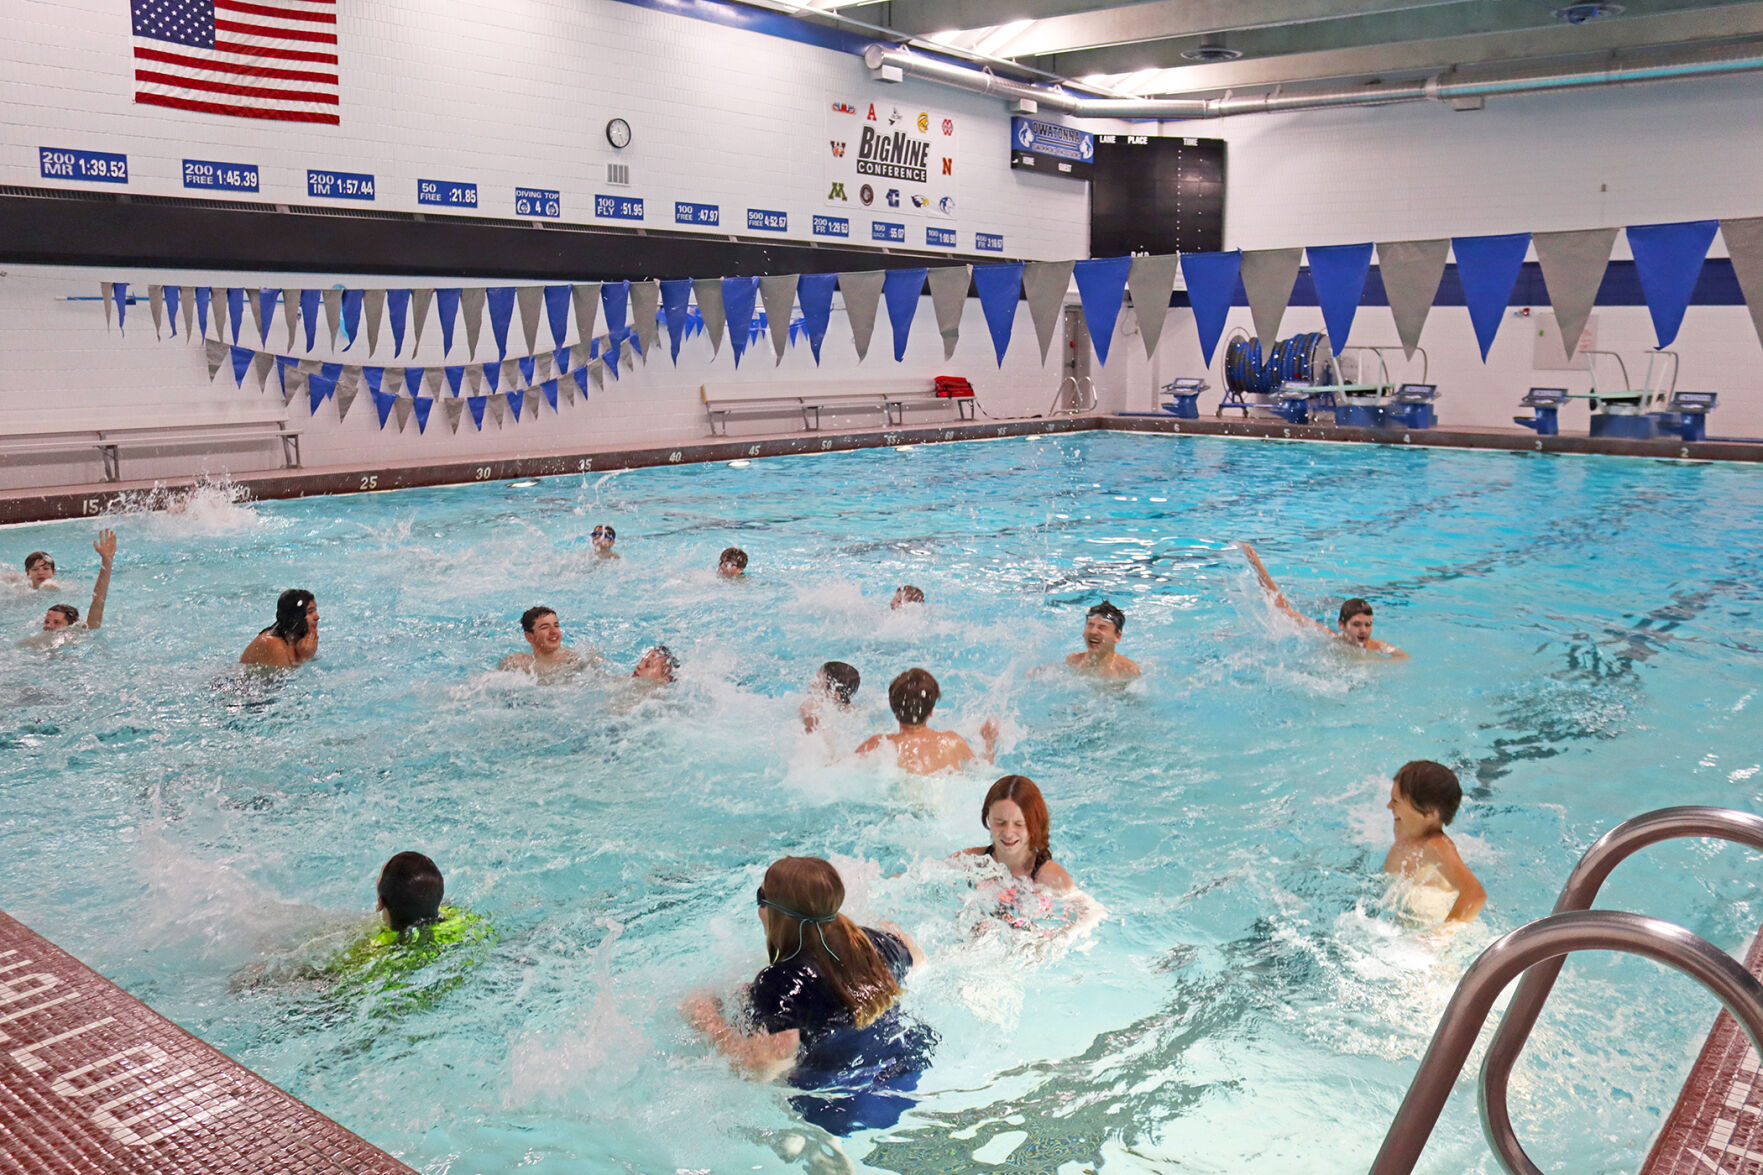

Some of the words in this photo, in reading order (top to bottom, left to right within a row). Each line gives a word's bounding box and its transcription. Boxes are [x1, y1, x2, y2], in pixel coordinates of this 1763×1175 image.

[867, 103, 877, 121] A
[1032, 121, 1080, 142] OWATONNA
[1127, 135, 1148, 145] PLACE
[42, 151, 75, 164] 200
[44, 163, 74, 176] MR
[78, 158, 126, 178] 1:39.52
[185, 163, 213, 176] 200
[858, 162, 926, 181] CONFERENCE
[942, 157, 952, 176] N
[185, 175, 214, 185] FREE
[216, 169, 258, 187] 1:45.39
[309, 173, 334, 185] 200
[313, 184, 331, 195] IM
[336, 178, 374, 195] 1:57.44
[421, 183, 437, 193] 50
[828, 182, 848, 201] M
[420, 192, 442, 202] FREE
[516, 190, 542, 199] DIVING
[544, 192, 559, 200] TOP
[534, 200, 541, 214] 4
[597, 198, 615, 207] 100
[597, 206, 615, 215] FLY
[677, 205, 693, 214] 100
[748, 211, 764, 219] 500
[677, 213, 693, 221] FREE
[813, 217, 828, 226] 200
[816, 225, 826, 233] FR
[1173, 423, 1181, 433] 6
[1283, 428, 1291, 438] 5
[1403, 433, 1411, 443] 4
[820, 439, 833, 450] 50
[1535, 440, 1543, 450] 3
[748, 444, 760, 457] 45
[1681, 447, 1689, 458] 2
[668, 451, 683, 463] 40
[578, 458, 592, 472] 35
[475, 466, 493, 480] 30
[360, 475, 378, 490] 25
[82, 499, 99, 515] 15
